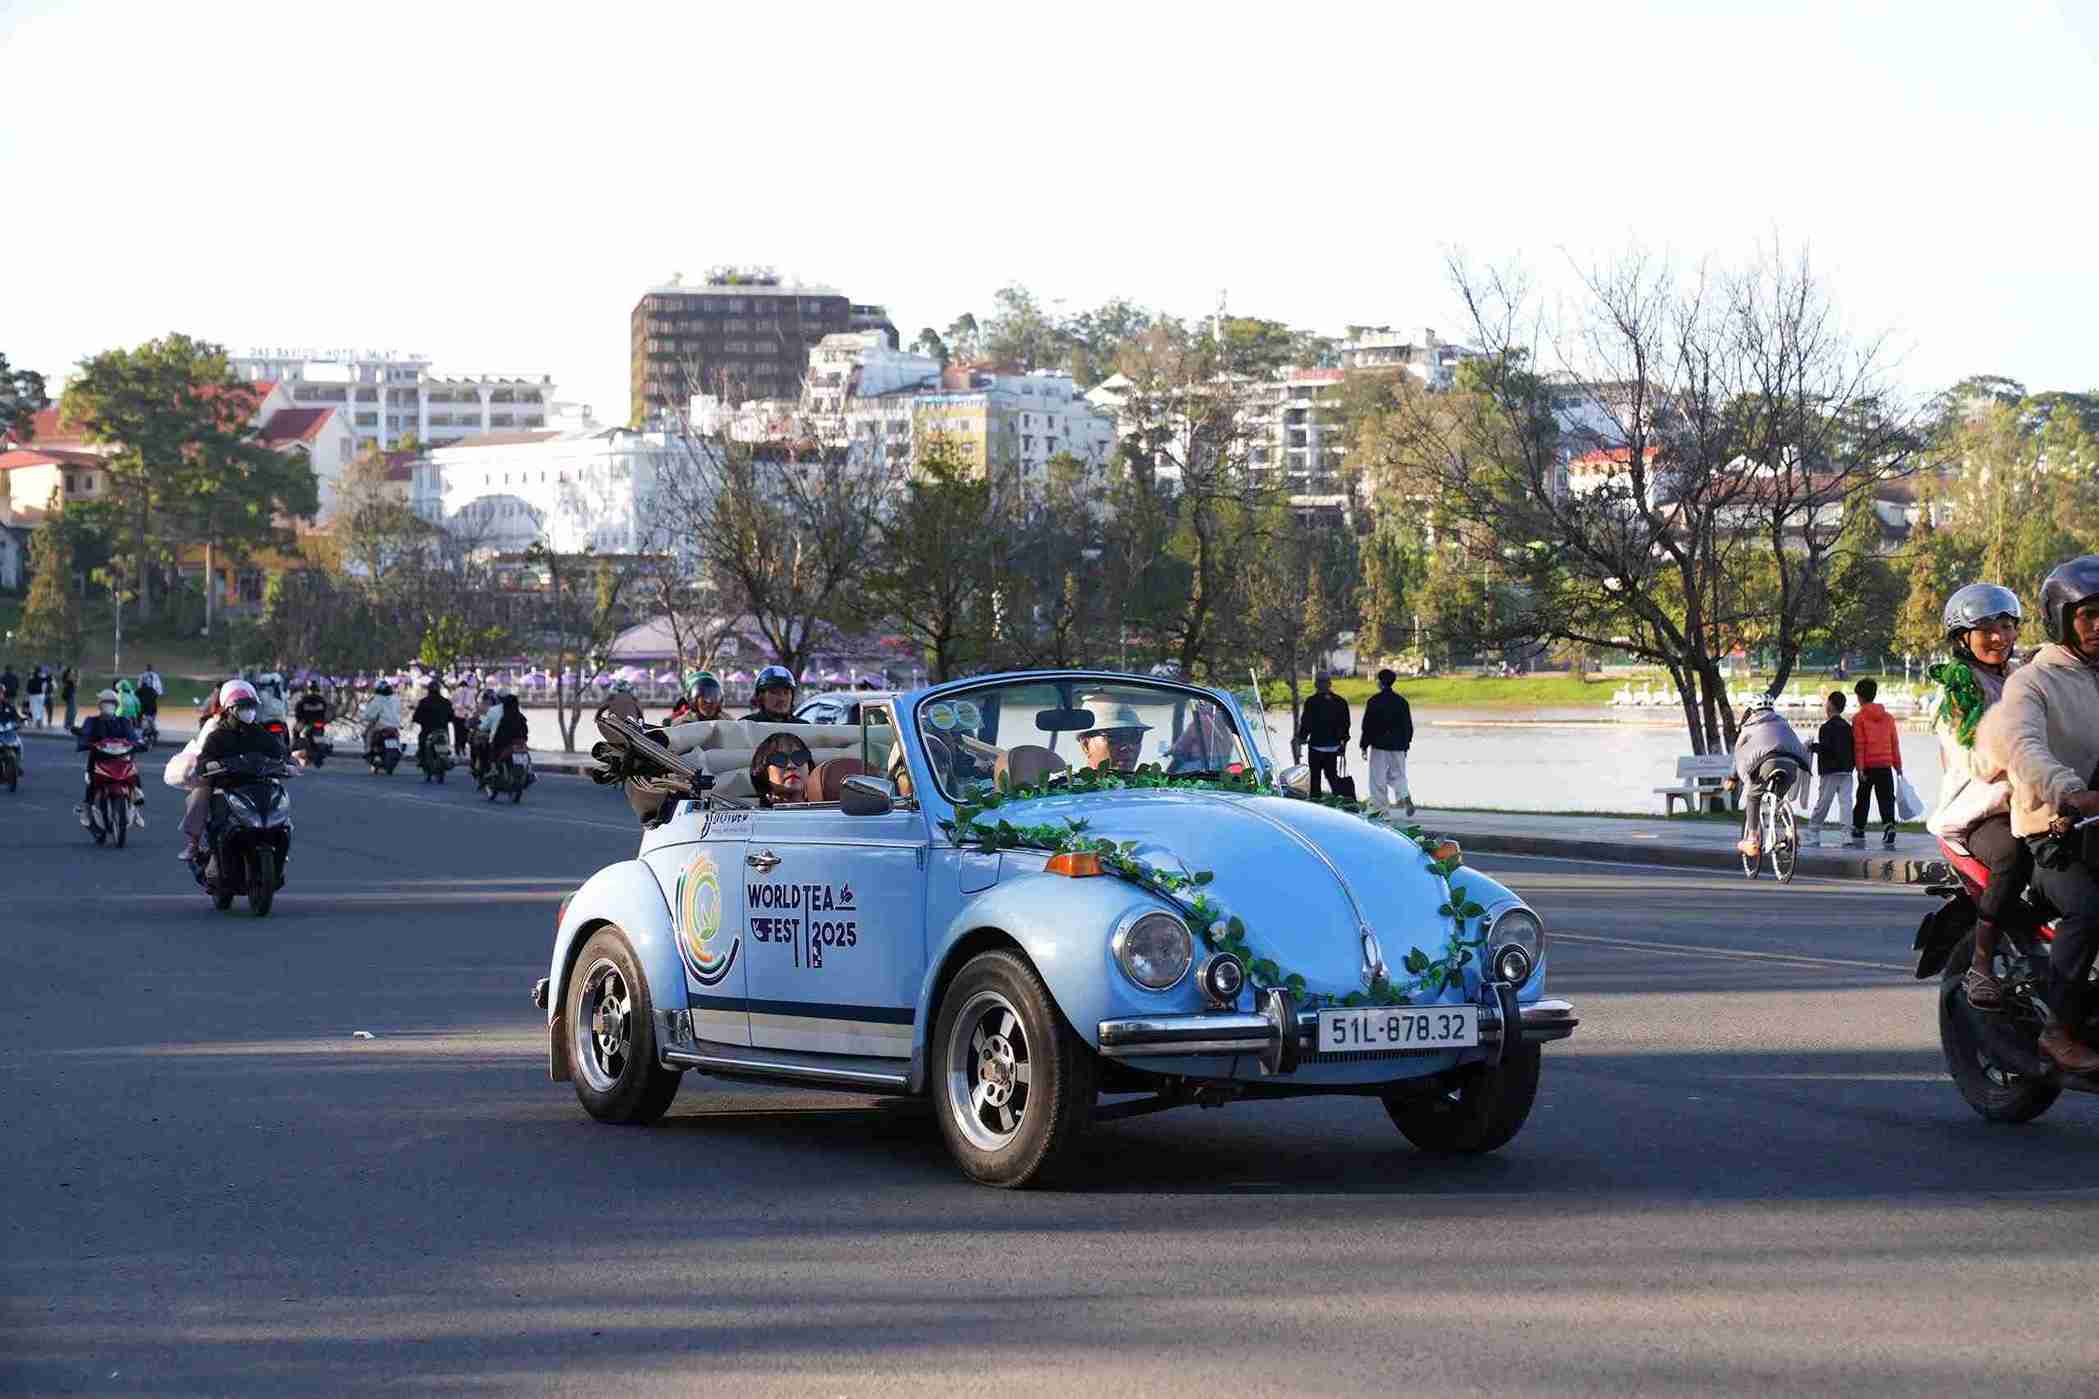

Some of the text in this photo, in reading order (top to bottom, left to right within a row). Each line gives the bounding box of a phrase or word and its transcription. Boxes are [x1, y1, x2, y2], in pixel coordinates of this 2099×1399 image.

[747, 884, 801, 909] WORLD
[812, 921, 857, 948] 2025
[1332, 1014, 1465, 1044] 51L-878.32
